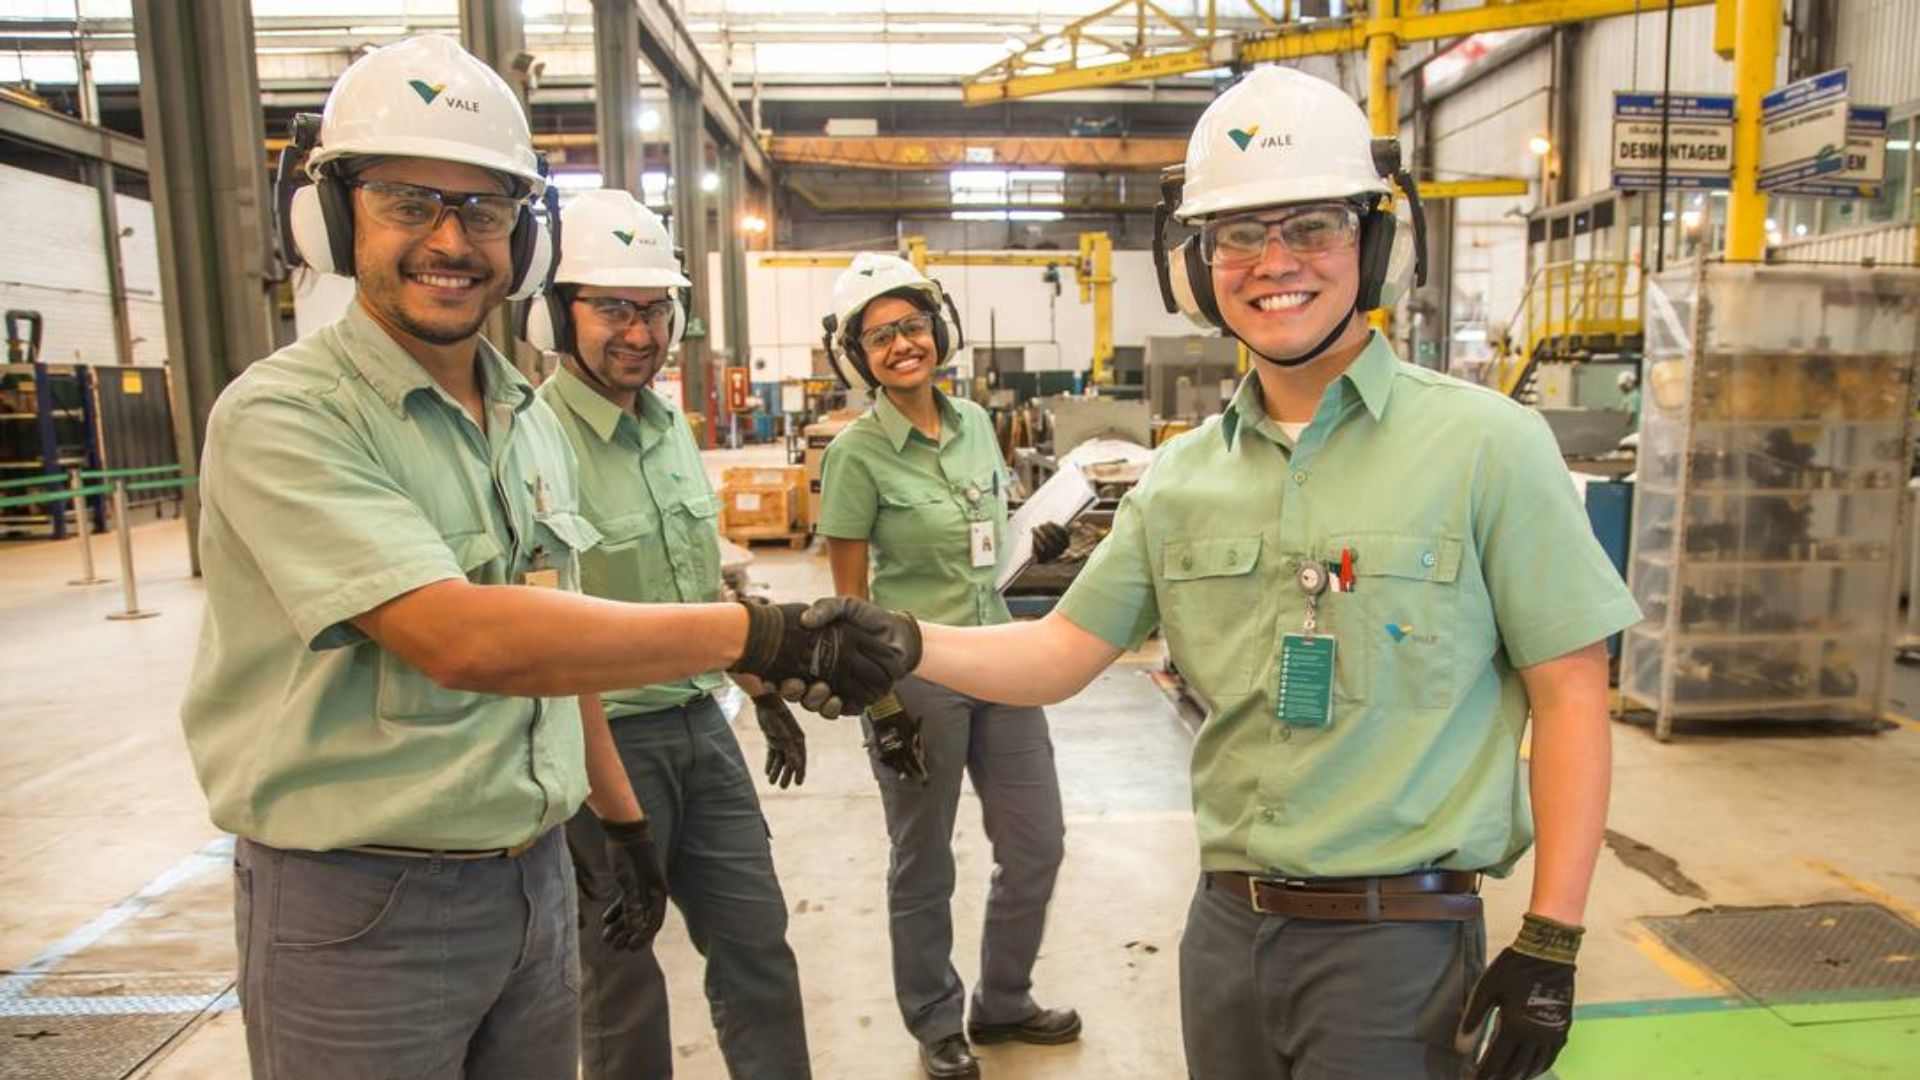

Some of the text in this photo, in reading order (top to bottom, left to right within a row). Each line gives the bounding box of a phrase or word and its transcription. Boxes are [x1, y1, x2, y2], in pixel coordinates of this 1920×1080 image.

[445, 97, 479, 113] VALE
[1261, 134, 1293, 148] VALE
[1620, 142, 1727, 161] DESMNTAGEM
